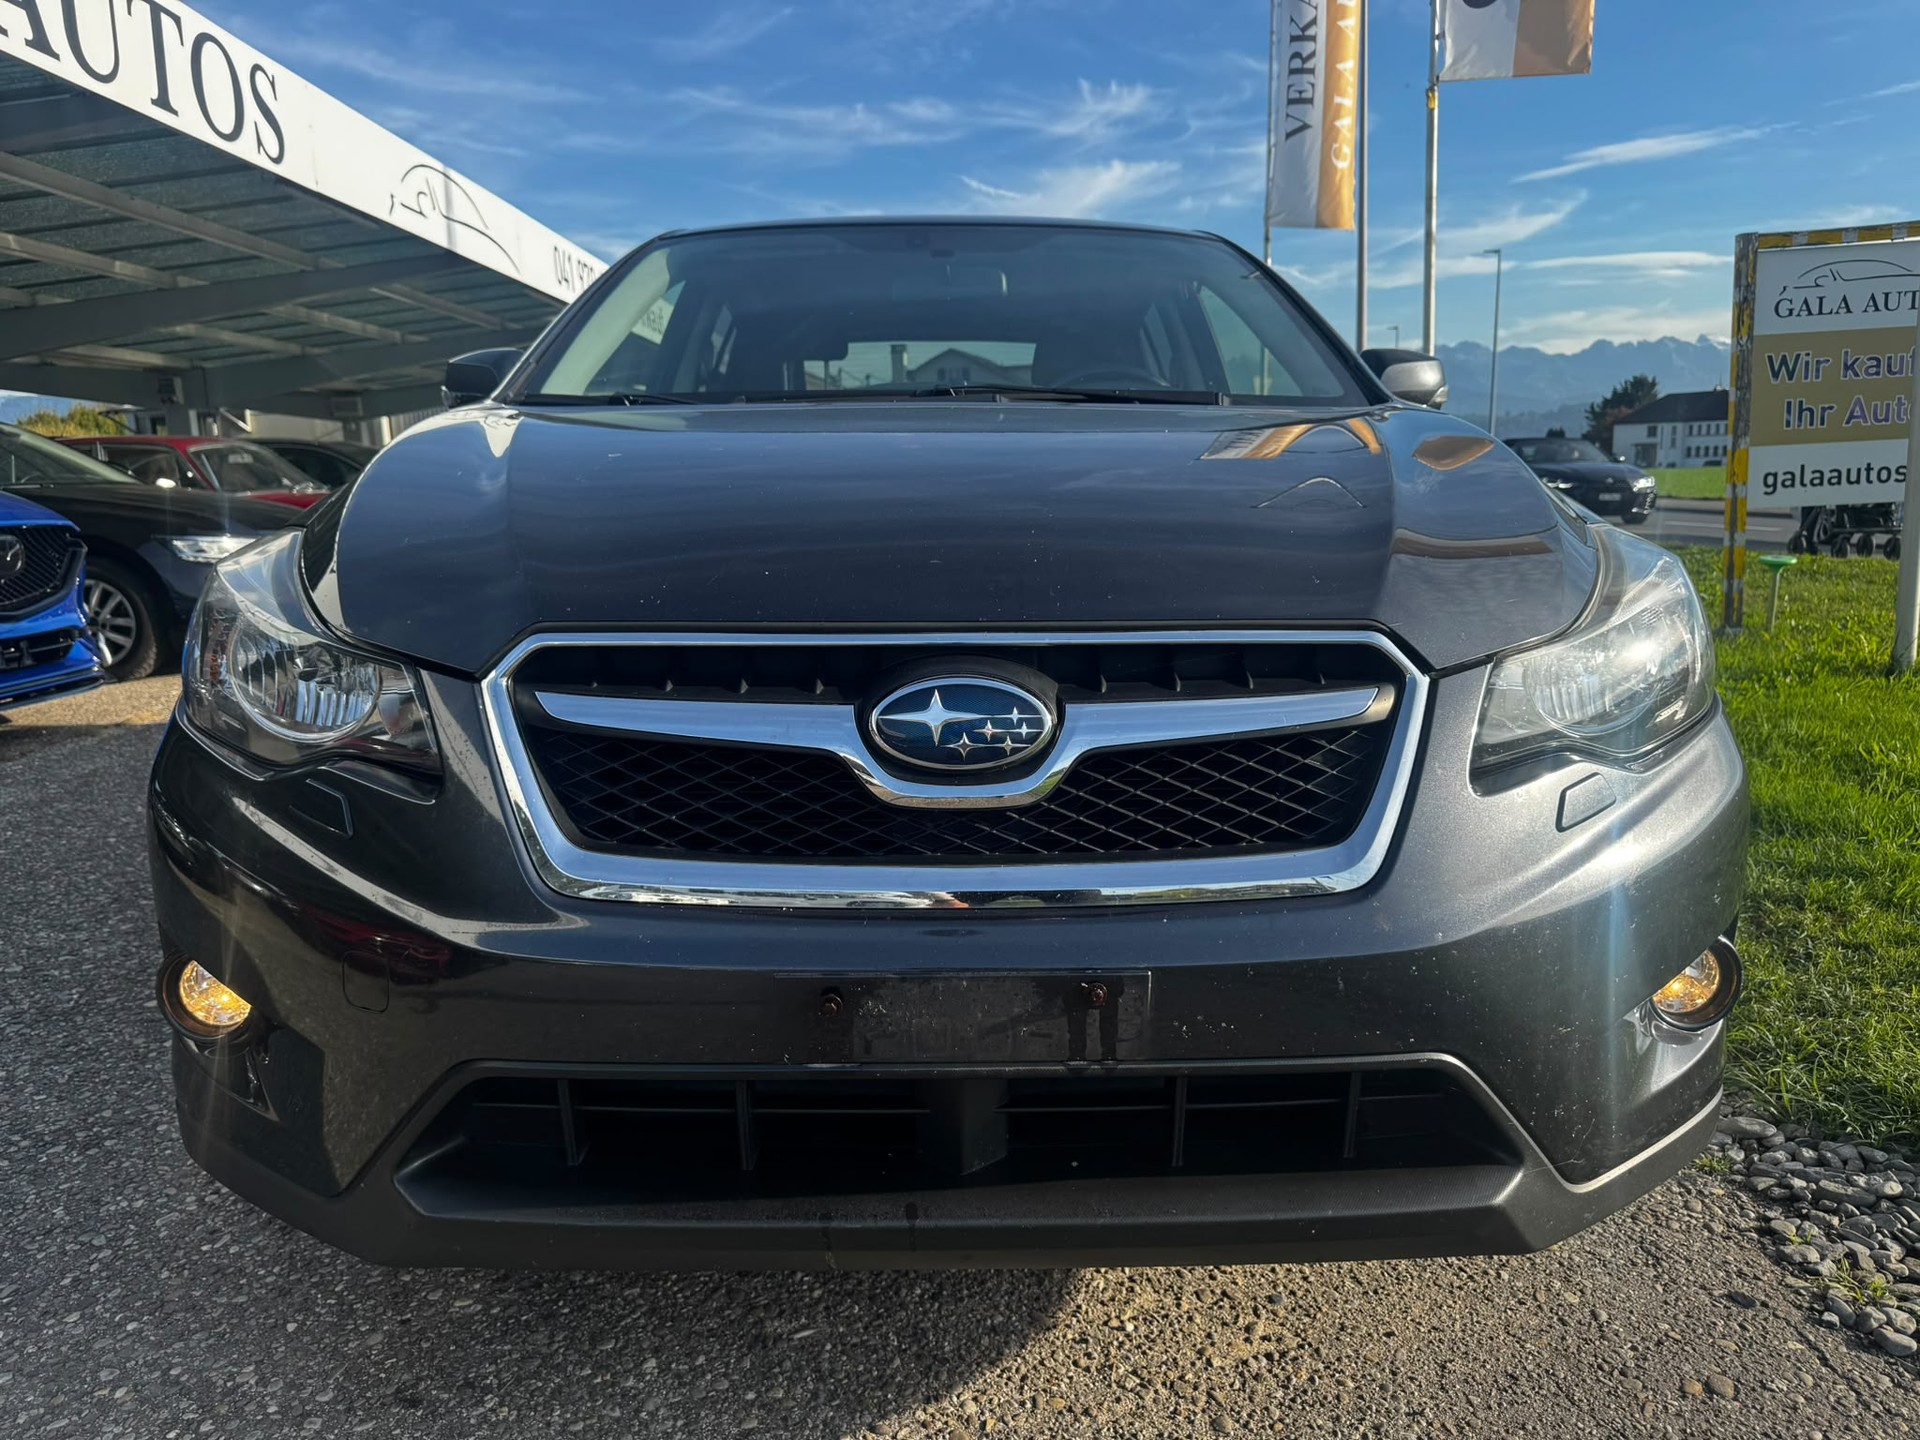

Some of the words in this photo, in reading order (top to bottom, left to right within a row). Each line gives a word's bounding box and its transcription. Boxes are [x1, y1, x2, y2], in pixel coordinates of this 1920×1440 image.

[1330, 56, 1356, 170] GALA
[1774, 294, 1853, 318] GALA
[1766, 352, 1831, 384] Wir
[1783, 398, 1836, 429] Ihr
[1842, 394, 1912, 427] Aut
